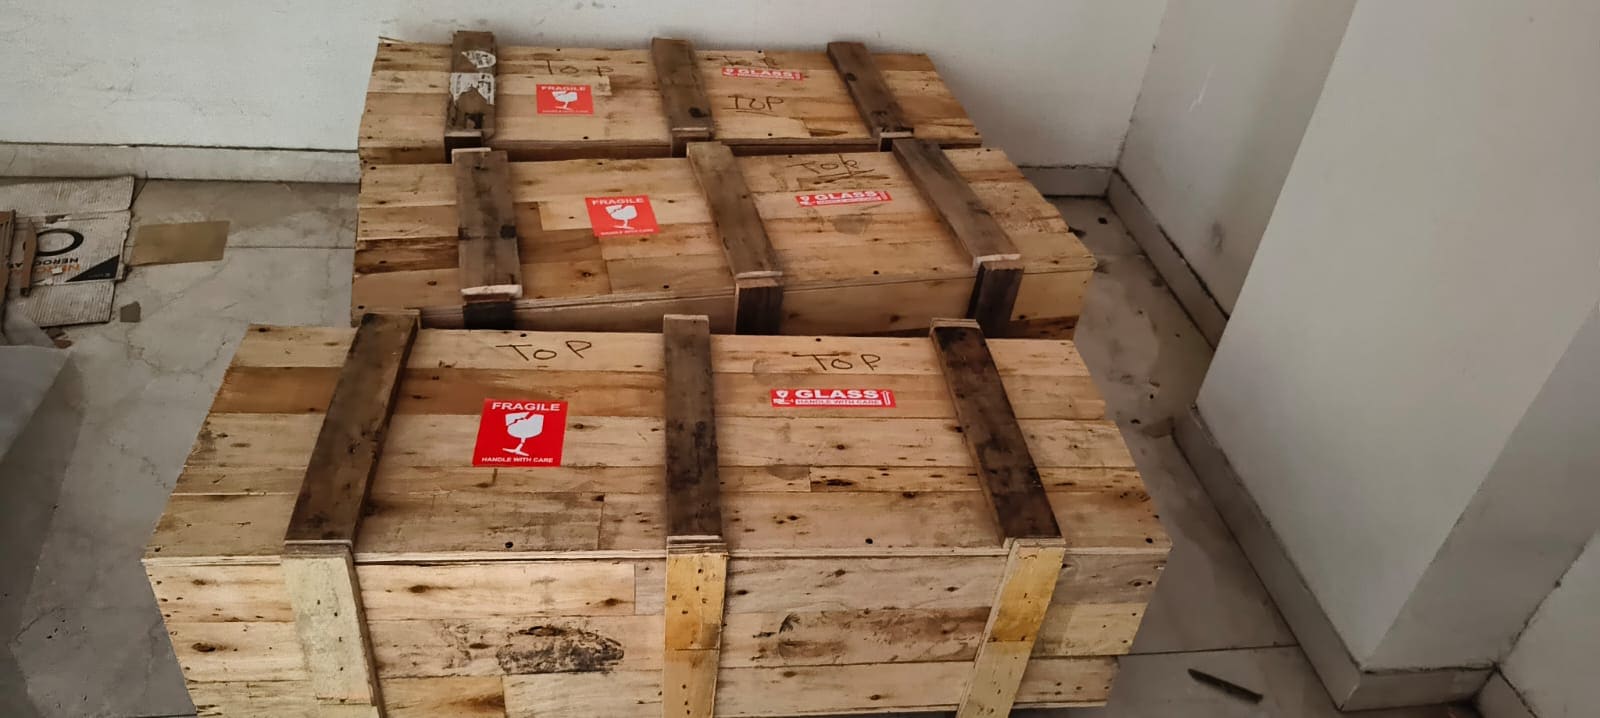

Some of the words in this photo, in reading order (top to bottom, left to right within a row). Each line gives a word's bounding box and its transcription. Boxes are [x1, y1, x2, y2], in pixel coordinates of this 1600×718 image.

[814, 191, 878, 200] GLASS
[592, 197, 644, 206] FRAGILE
[495, 340, 592, 361] TOP
[795, 389, 879, 399] GLASS
[491, 401, 561, 412] FRAGILE
